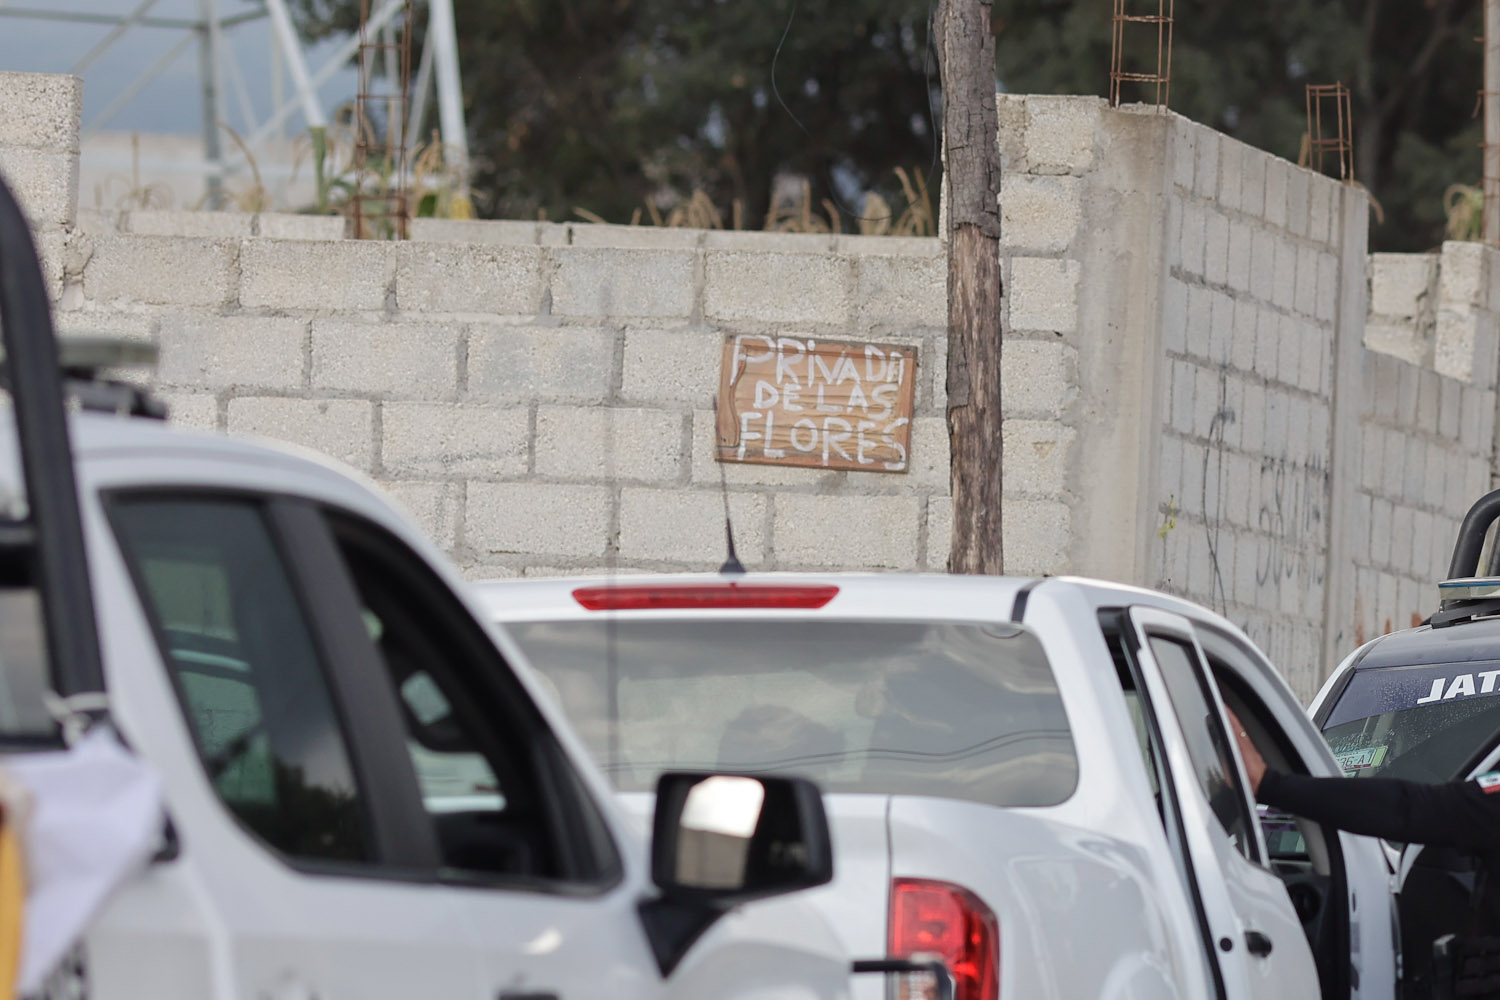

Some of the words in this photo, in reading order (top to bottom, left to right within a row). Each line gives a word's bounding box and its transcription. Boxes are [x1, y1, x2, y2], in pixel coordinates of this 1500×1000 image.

[753, 379, 804, 411] DE
[816, 382, 898, 420] LAS
[737, 410, 909, 470] FLORES
